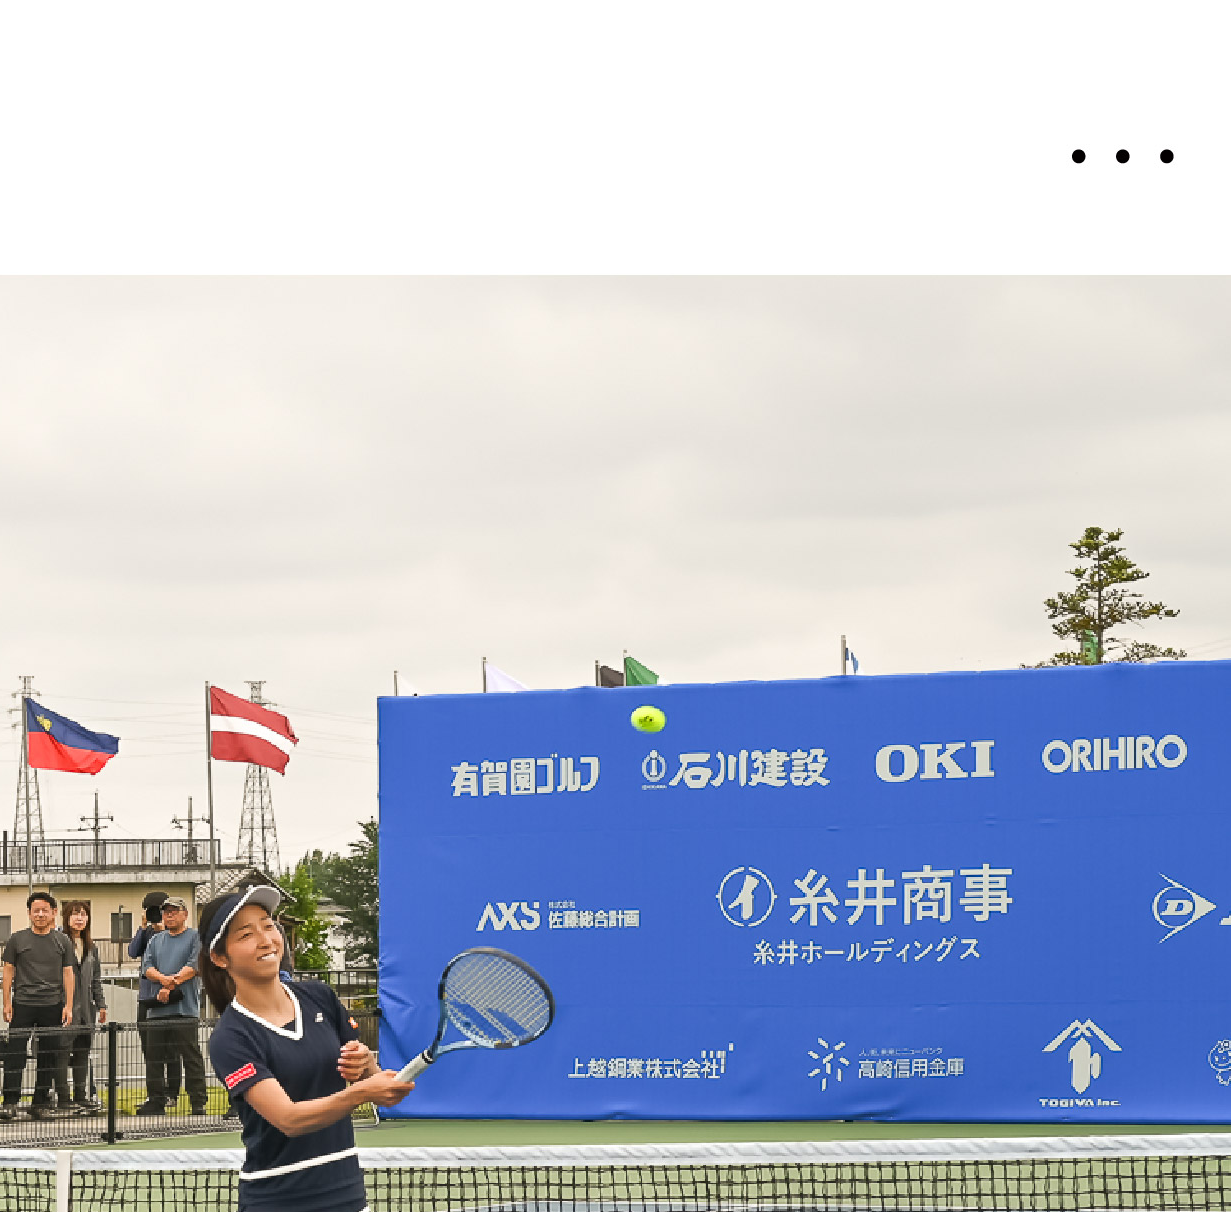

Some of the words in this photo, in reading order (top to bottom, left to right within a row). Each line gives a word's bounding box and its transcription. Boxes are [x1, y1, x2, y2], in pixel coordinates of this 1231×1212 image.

[669, 749, 830, 788] 石川建設
[876, 740, 994, 782] OKI
[1042, 735, 1187, 773] ORIHIRO
[451, 753, 600, 797] 有賀園ゴルフ
[789, 863, 1013, 926] 糸井商事
[475, 901, 541, 931] AXS
[548, 909, 640, 929] 佐藤総合計画
[753, 935, 981, 965] 糸井ホールディングス
[858, 1057, 965, 1079] 高崎信用金庫
